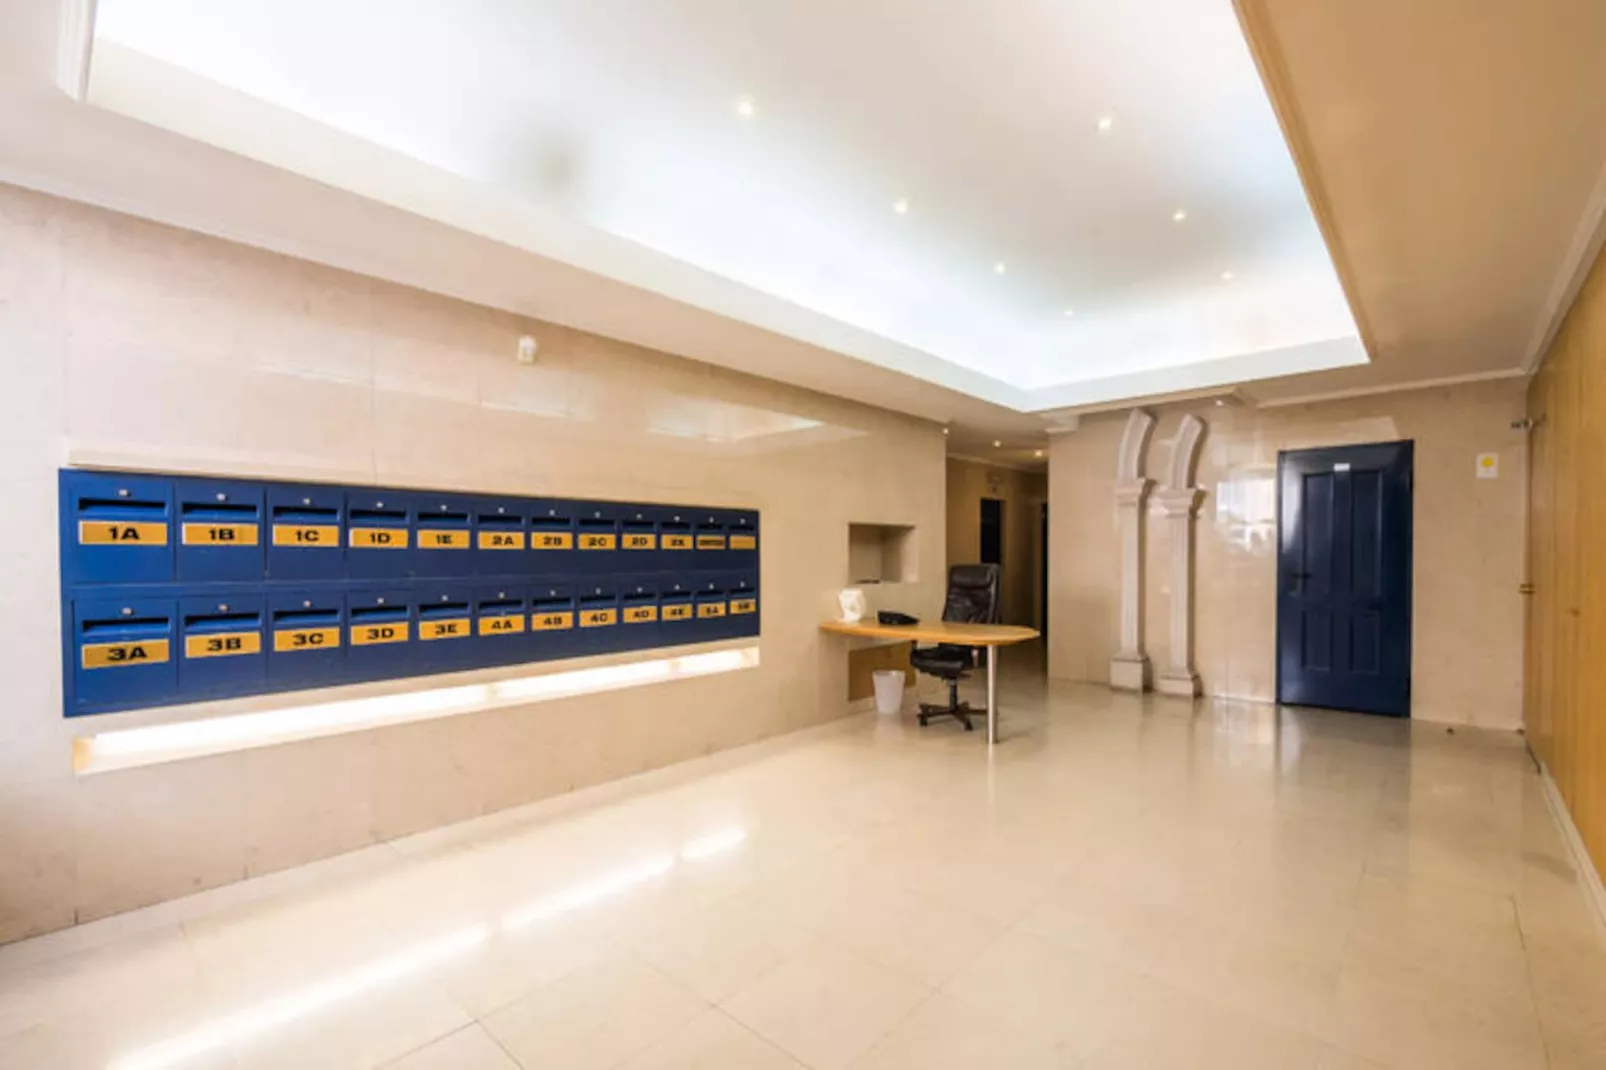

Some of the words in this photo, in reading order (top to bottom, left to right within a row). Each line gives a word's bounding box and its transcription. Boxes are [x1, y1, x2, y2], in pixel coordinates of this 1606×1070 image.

[108, 526, 140, 540] 1A
[208, 528, 235, 540] 1B
[295, 529, 319, 542] 1C
[370, 532, 391, 544] 1D
[436, 535, 453, 545] 1E
[491, 535, 514, 546] 2A
[543, 536, 563, 546] 2B
[588, 537, 607, 546] 2C
[631, 537, 648, 546] 2D
[543, 617, 563, 626] 4B
[590, 613, 608, 623] 4C
[435, 624, 457, 635] 3E
[491, 619, 513, 630] 4A
[293, 633, 324, 645] 3C
[367, 628, 395, 640] 3D
[207, 638, 242, 651] 3B
[107, 646, 147, 661] 3A
